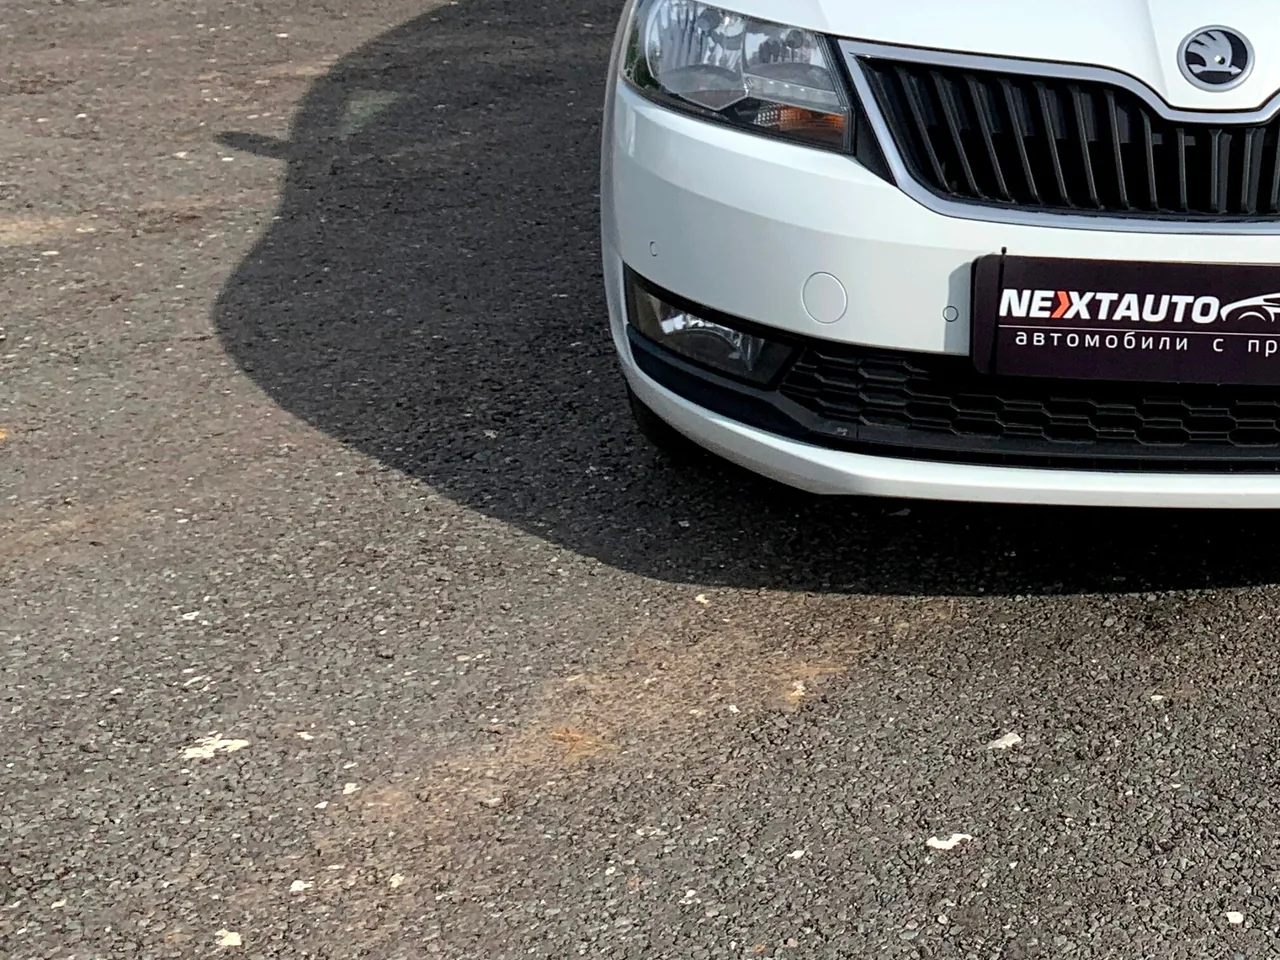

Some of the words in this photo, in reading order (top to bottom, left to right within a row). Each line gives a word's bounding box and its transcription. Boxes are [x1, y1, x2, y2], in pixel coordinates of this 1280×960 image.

[999, 288, 1220, 324] NEXTAUTO
[1015, 329, 1188, 351] автомобили
[1212, 338, 1224, 353] с
